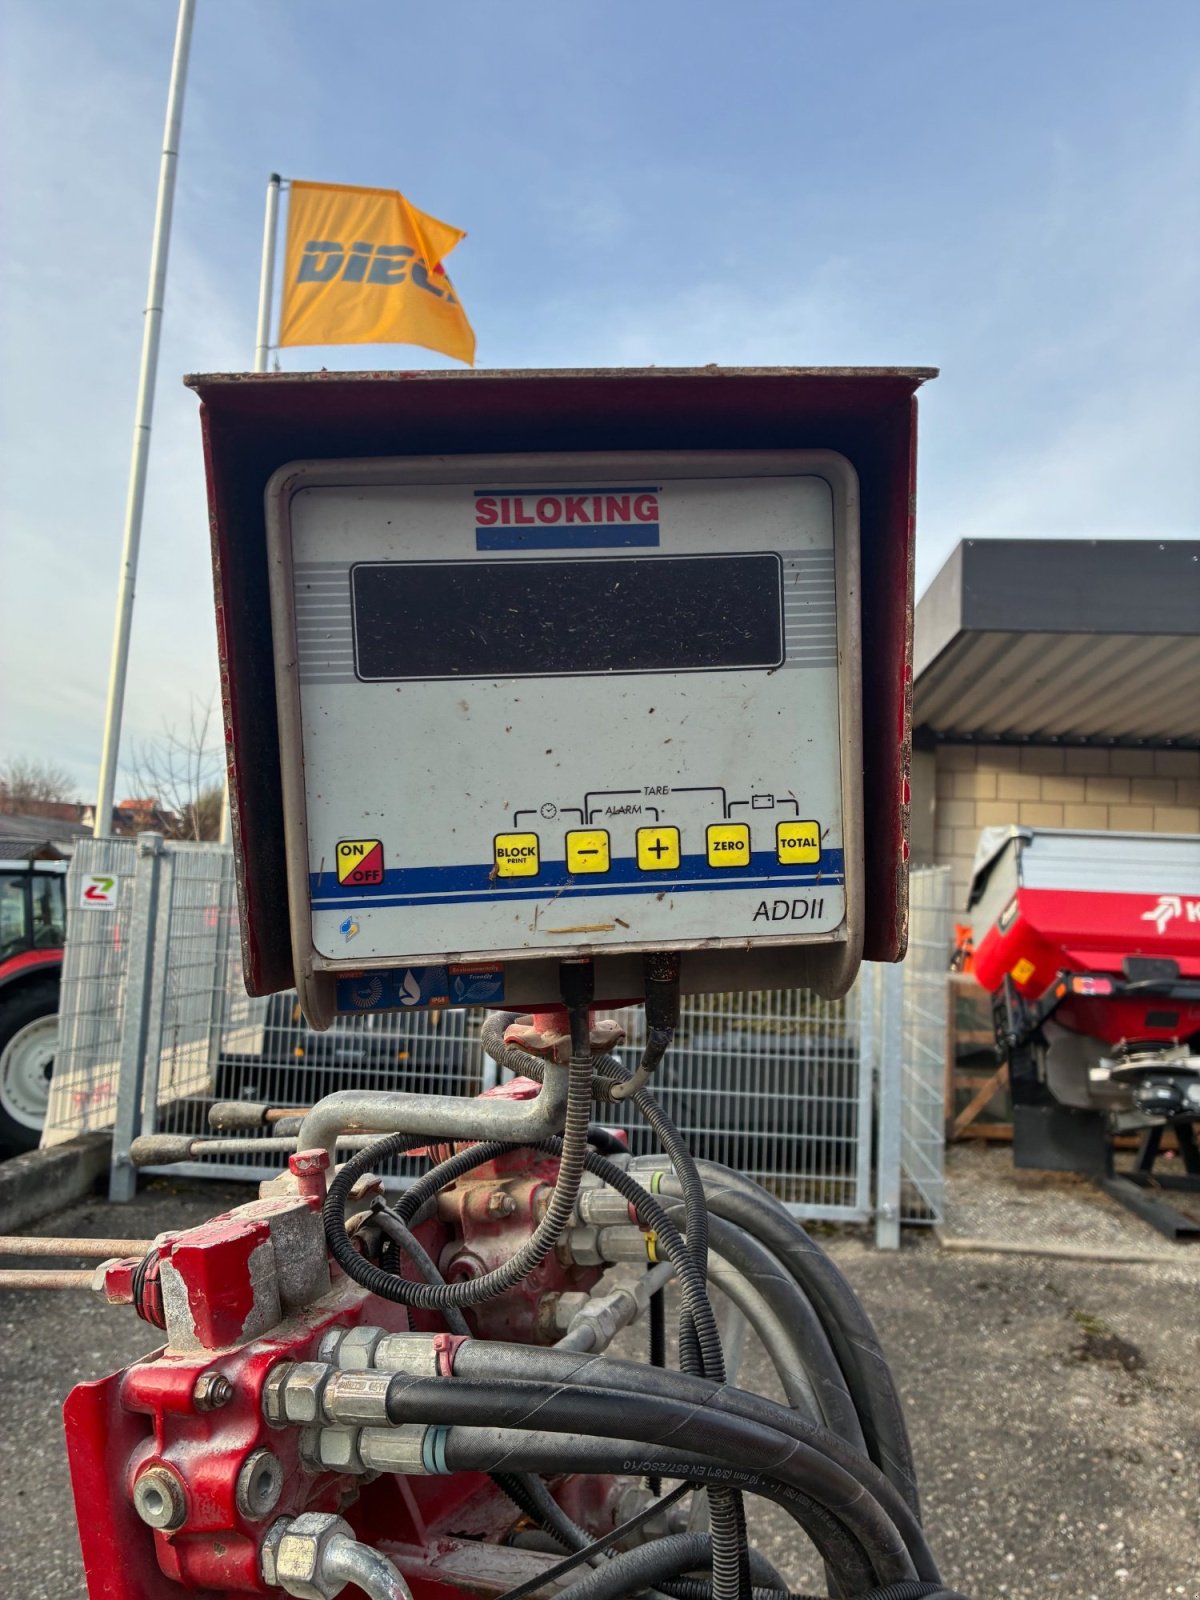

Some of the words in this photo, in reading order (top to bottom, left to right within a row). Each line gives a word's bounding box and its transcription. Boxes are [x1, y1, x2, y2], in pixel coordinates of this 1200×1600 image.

[475, 494, 659, 525] SILOKING
[644, 786, 669, 796] TARE
[605, 804, 642, 816] ALARM
[713, 841, 745, 851] ZERO
[780, 838, 817, 848] TOTAL
[340, 845, 364, 856] ON
[497, 846, 536, 858] BLOCK
[352, 870, 380, 882] OFF
[689, 1464, 707, 1476] EN
